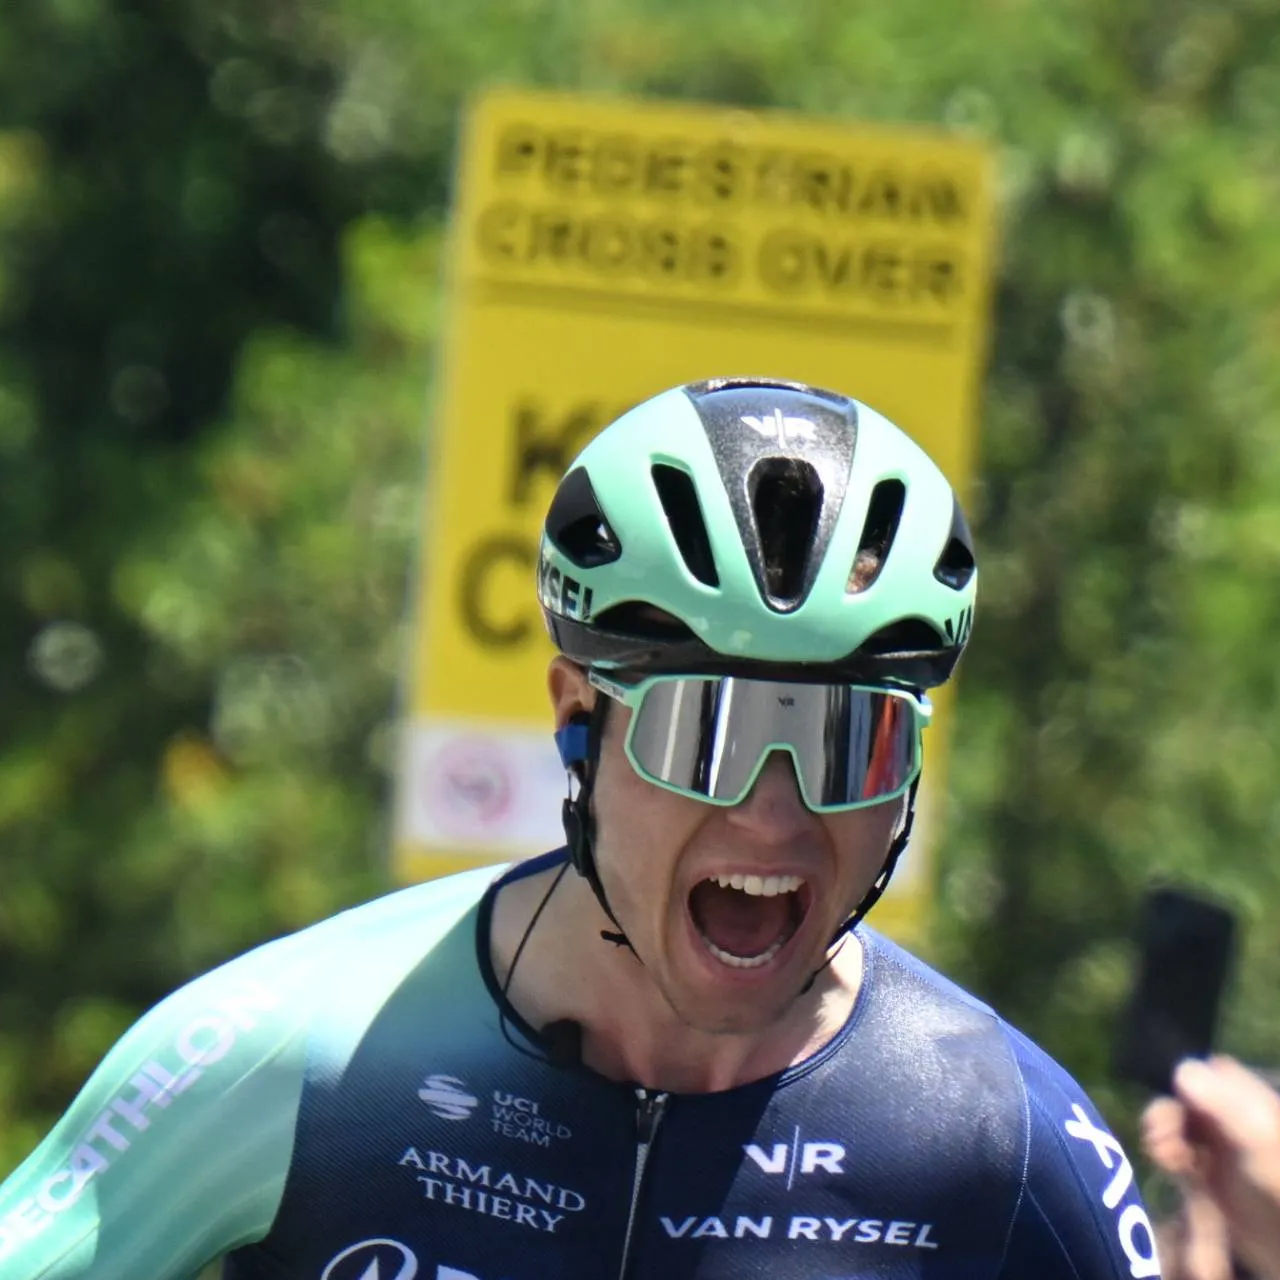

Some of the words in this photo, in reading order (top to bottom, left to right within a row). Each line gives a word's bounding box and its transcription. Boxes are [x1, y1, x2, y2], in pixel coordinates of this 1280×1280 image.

[494, 122, 968, 226] PEDESTRIAN
[474, 202, 744, 286] CROSS
[757, 228, 968, 305] OVER
[493, 1090, 539, 1114] UCI
[493, 1104, 573, 1139] WORLD
[490, 1118, 550, 1148] TEAM
[397, 1146, 586, 1213] ARMAND
[417, 1176, 567, 1234] THIERY
[659, 1215, 772, 1240] VAN
[787, 1216, 940, 1249] RYSEL
